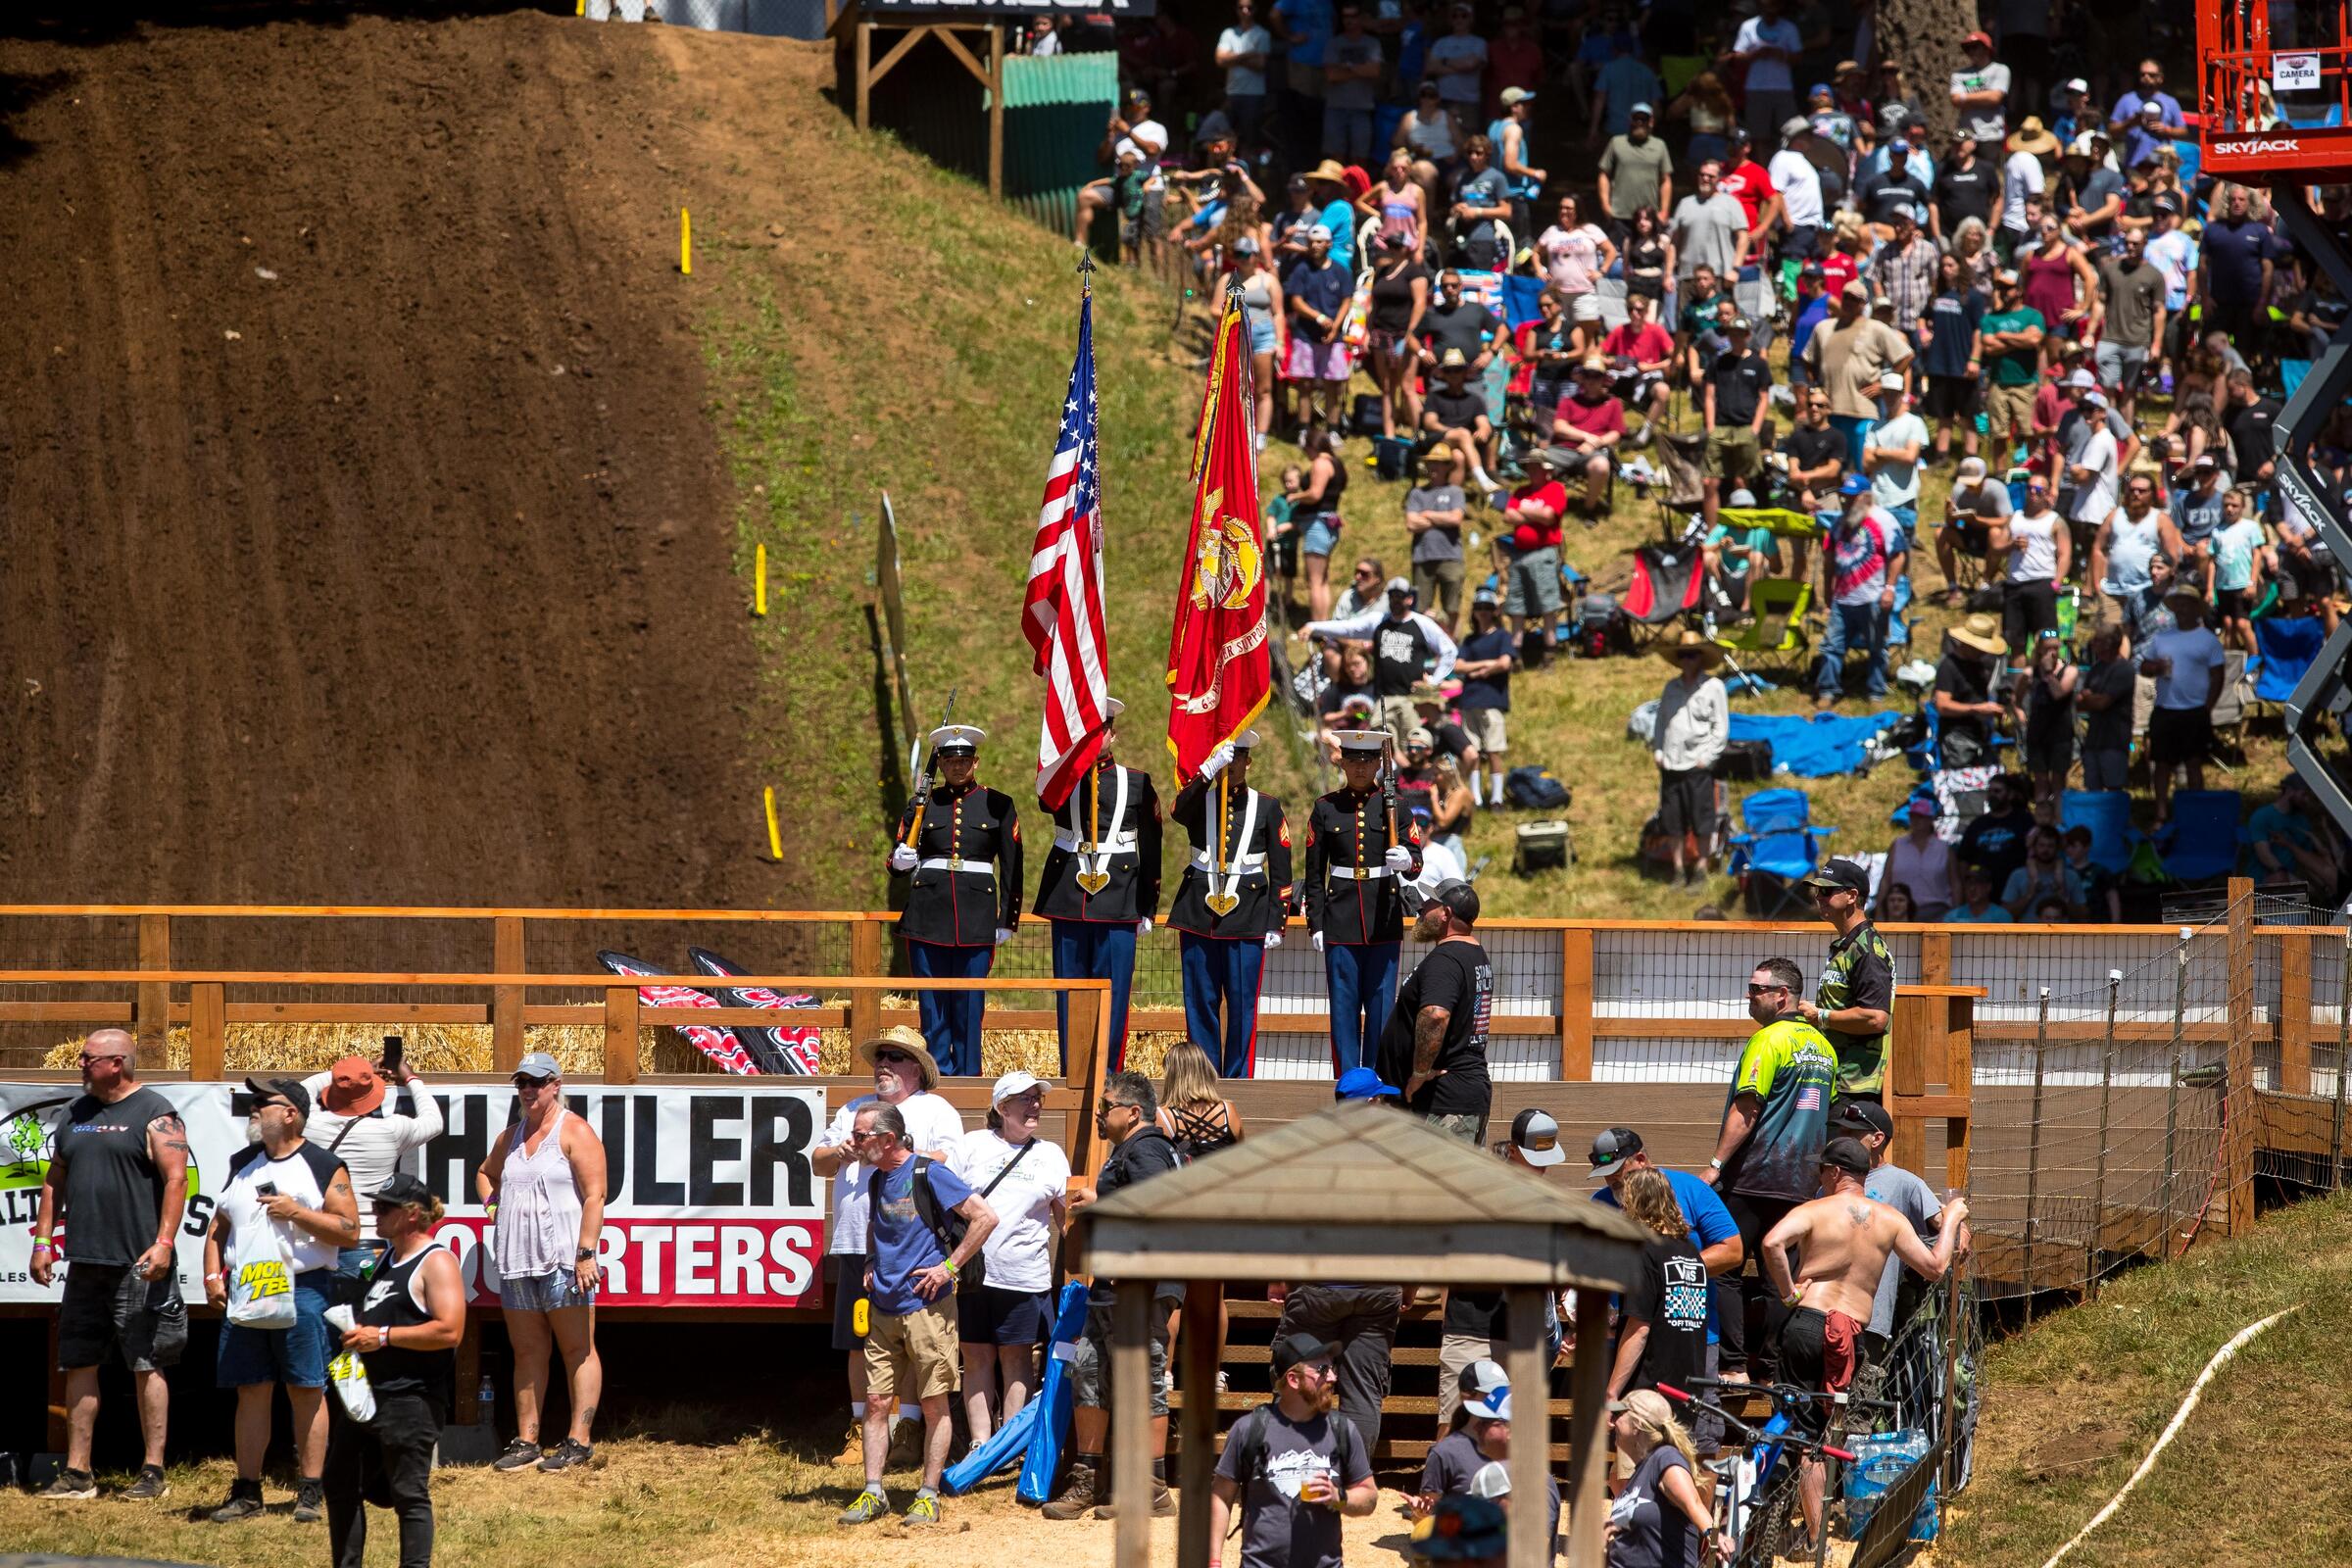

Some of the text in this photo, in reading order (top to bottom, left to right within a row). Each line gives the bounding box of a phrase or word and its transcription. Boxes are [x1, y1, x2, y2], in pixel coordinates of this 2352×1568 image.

[2279, 70, 2316, 79] CAMERA
[2214, 139, 2300, 156] SKYJACK
[2278, 472, 2327, 533] SKYJACK
[1211, 645, 1236, 696] ENGINER
[426, 1094, 815, 1207] HULER
[239, 1260, 284, 1287] MOT
[1674, 1263, 1697, 1283] VS
